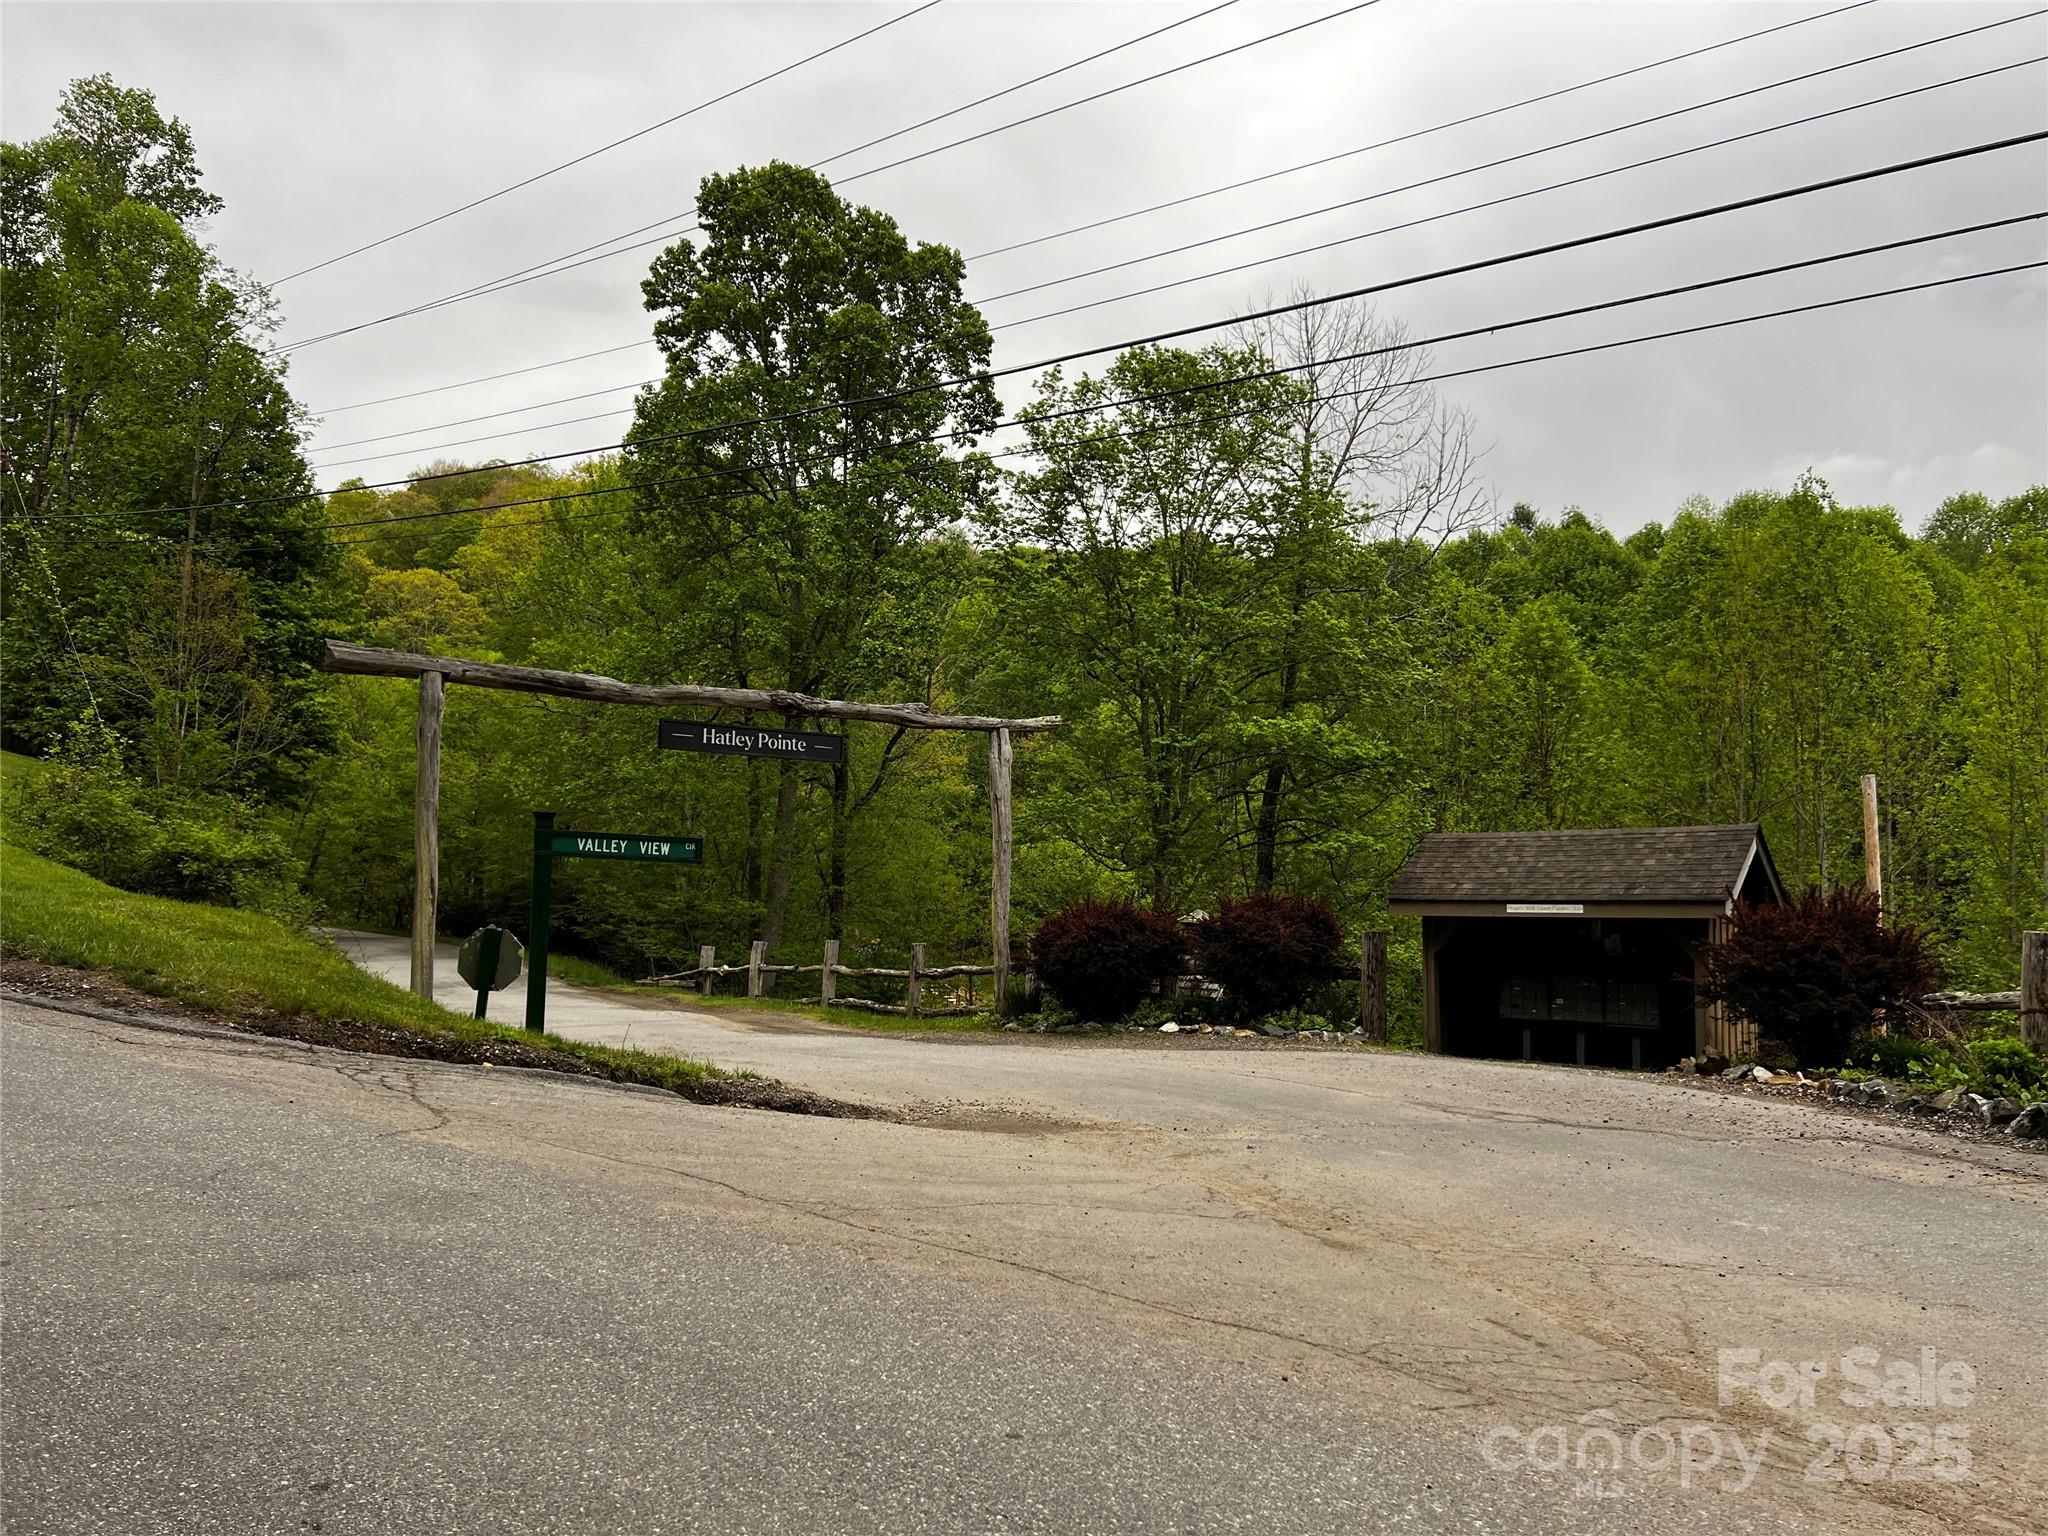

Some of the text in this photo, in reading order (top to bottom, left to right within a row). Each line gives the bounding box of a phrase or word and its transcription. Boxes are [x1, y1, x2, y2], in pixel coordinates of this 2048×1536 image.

[702, 727, 807, 752] Hatley Pointe
[577, 837, 628, 854] VALLEY
[640, 841, 671, 856] VIEW
